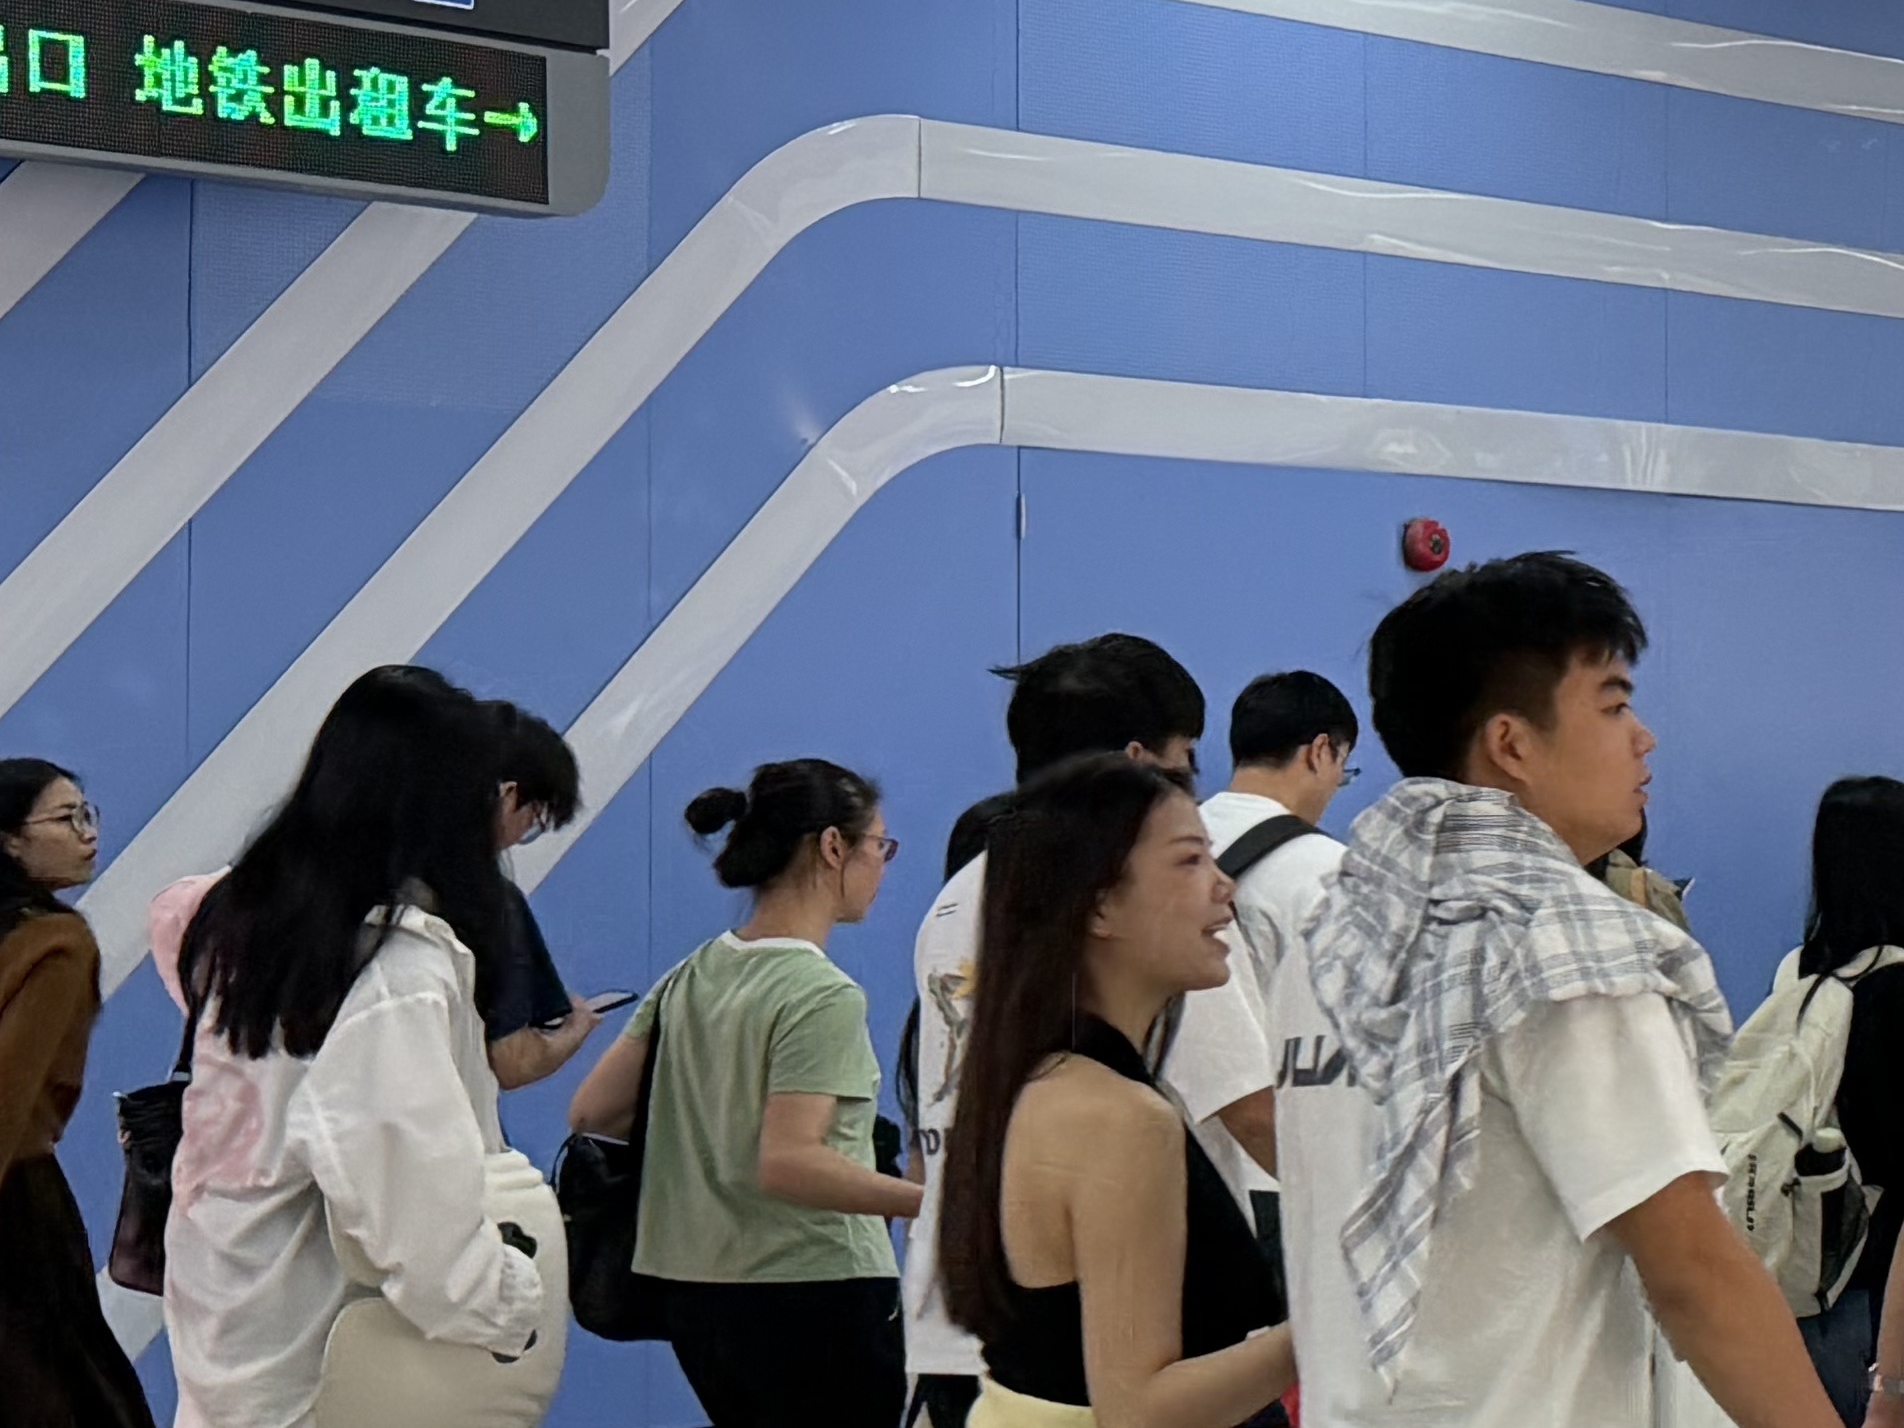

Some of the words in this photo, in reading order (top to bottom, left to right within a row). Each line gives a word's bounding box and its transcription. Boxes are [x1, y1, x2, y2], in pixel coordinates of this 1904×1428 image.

[135, 34, 480, 151] 地铁出租车
